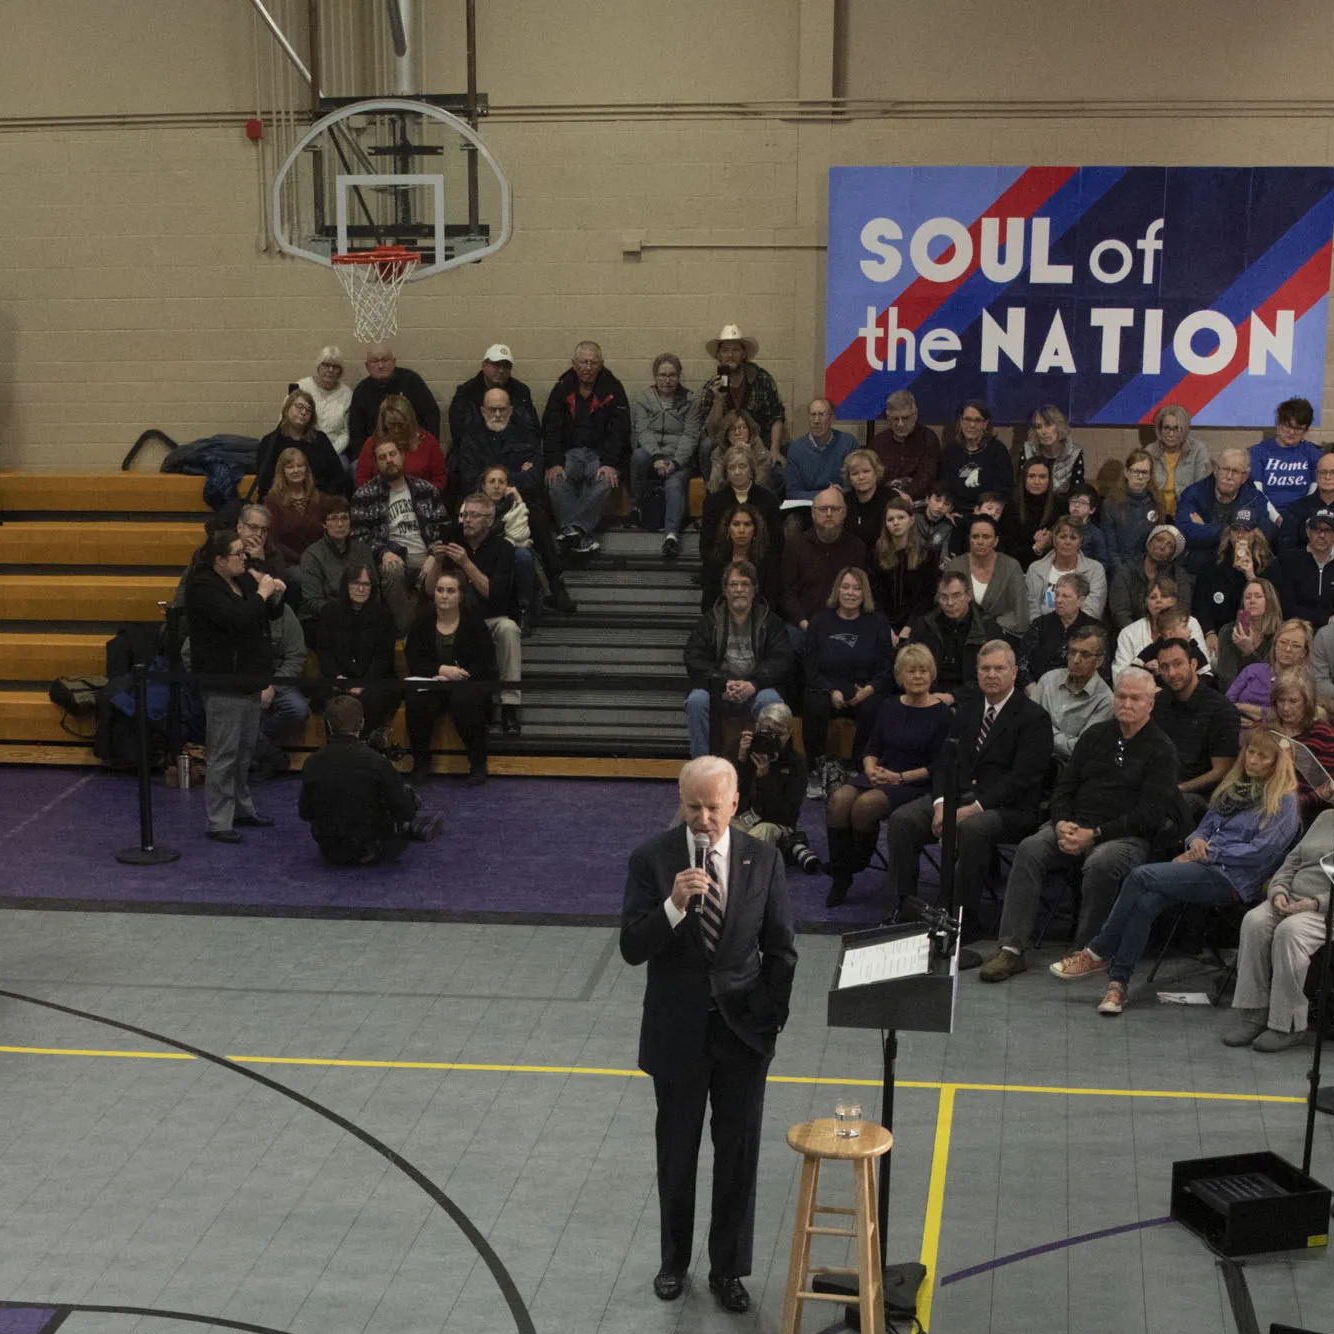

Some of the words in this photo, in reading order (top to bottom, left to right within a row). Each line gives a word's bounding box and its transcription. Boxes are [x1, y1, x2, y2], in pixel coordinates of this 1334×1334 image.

[859, 216, 1074, 284] SOUL
[1088, 217, 1165, 285] of
[858, 305, 962, 372] the
[980, 306, 1296, 377] NATION
[1265, 457, 1309, 471] Home
[1267, 472, 1307, 486] base.
